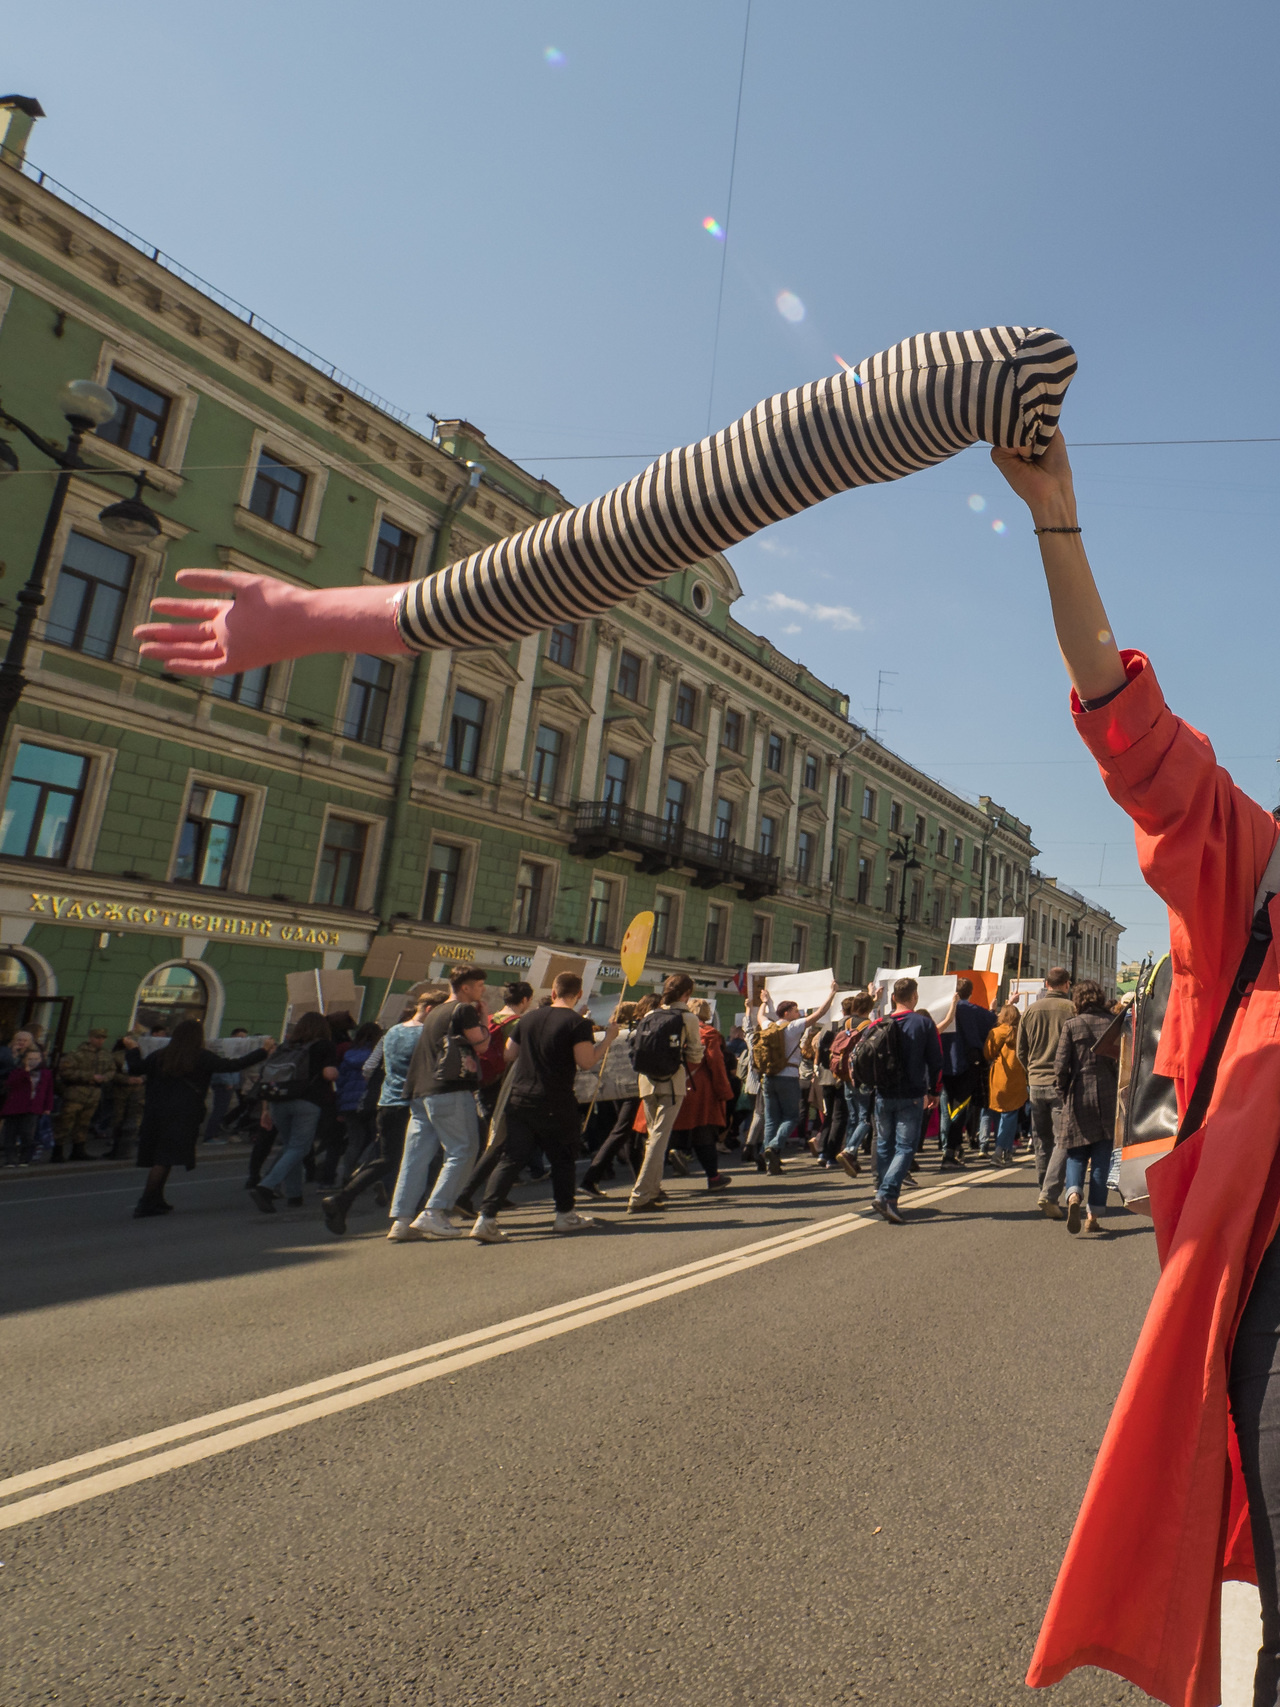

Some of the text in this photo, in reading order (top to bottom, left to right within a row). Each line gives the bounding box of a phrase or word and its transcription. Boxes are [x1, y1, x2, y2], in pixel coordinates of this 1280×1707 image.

[29, 893, 339, 946] ХУДОЖЕСТВЕННЫЙ САЛОН
[505, 955, 620, 977] ФИРМ АЗИН
